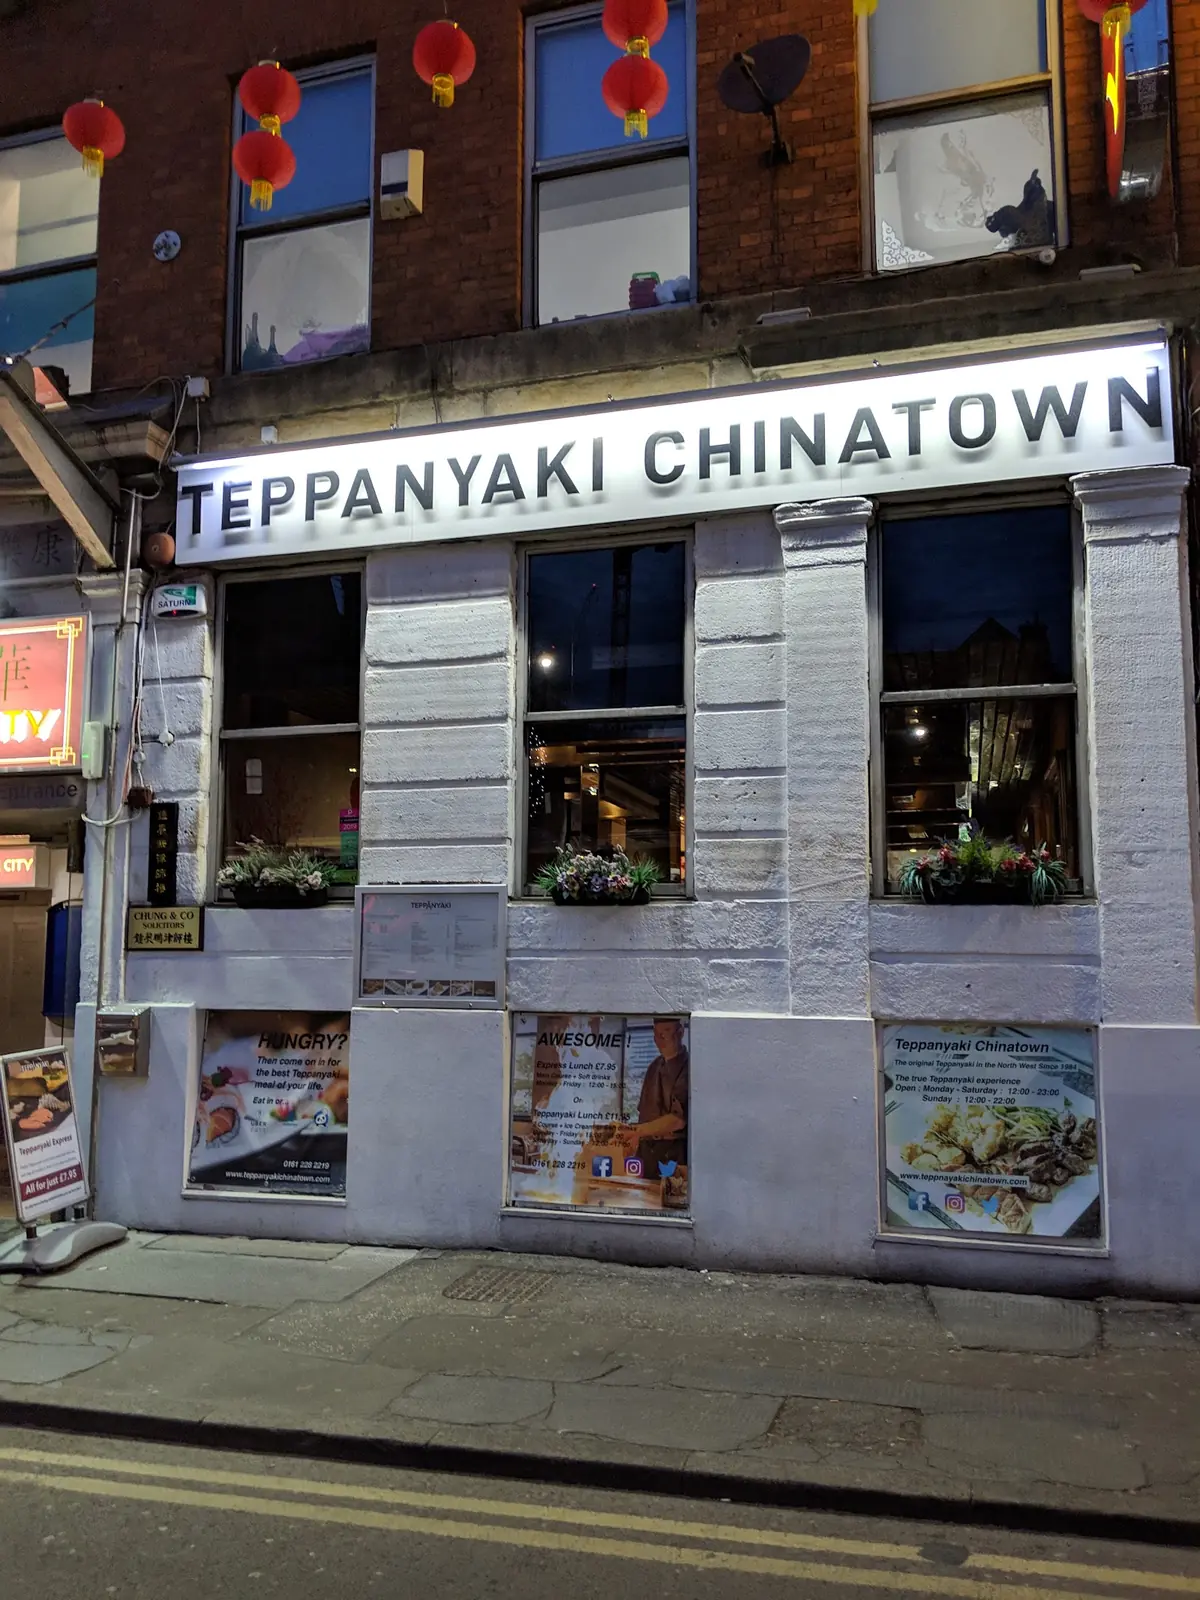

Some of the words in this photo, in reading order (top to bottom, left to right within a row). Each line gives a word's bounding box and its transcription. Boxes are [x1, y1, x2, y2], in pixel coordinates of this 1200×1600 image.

[181, 436, 603, 535] TEPPANYAKI
[644, 366, 1162, 484] CHINATOWN
[158, 599, 190, 609] SATURN
[3, 857, 34, 873] CITY
[134, 911, 167, 921] CHUNG
[170, 911, 178, 920] &
[180, 910, 195, 920] CO
[142, 921, 185, 929] SOLICITORS
[258, 1033, 348, 1050] HUNGRY?
[537, 1032, 621, 1048] AWESOME
[895, 1038, 971, 1053] Teppanyaki
[975, 1040, 1049, 1053] Chinatown
[257, 1056, 278, 1065] Then
[318, 1058, 327, 1066] in
[327, 1058, 341, 1067] for
[536, 1061, 567, 1071] Express
[568, 1062, 593, 1070] Lunch
[594, 1062, 617, 1071] £7.95
[908, 1060, 934, 1068] original
[936, 1060, 975, 1069] Teppanyaki
[1060, 1063, 1077, 1071] 1984
[256, 1068, 270, 1077] the
[271, 1069, 290, 1078] best
[292, 1069, 340, 1081] Teppanyaki
[895, 1074, 910, 1083] The
[911, 1075, 928, 1083] true
[929, 1075, 975, 1086] Teppanyaki
[976, 1077, 1021, 1086] experience
[255, 1081, 276, 1089] meal
[276, 1081, 286, 1090] of
[287, 1083, 307, 1091] your
[308, 1082, 324, 1091] life.
[563, 1081, 582, 1089] Friday
[894, 1084, 916, 1093] Open
[923, 1085, 955, 1095] Monday
[961, 1086, 998, 1096] Saturday
[1008, 1087, 1030, 1096] 12:00
[1037, 1088, 1060, 1096] 23:00
[253, 1096, 266, 1105] Eat
[267, 1096, 274, 1105] in
[922, 1094, 953, 1104] Sunday
[964, 1095, 986, 1104] 12:00
[993, 1097, 1016, 1105] 22:00
[535, 1110, 576, 1120] Teppanyaki
[578, 1111, 602, 1120] Lunch
[560, 1130, 577, 1138] Friday
[19, 1139, 52, 1156] Teppanyaki
[52, 1132, 73, 1147] Express
[562, 1138, 584, 1146] Sunday
[283, 1160, 299, 1168] 0161
[532, 1160, 549, 1168] 0161
[25, 1180, 36, 1195] All
[36, 1178, 46, 1192] for
[46, 1175, 59, 1190] just
[60, 1168, 77, 1183] £7.95
